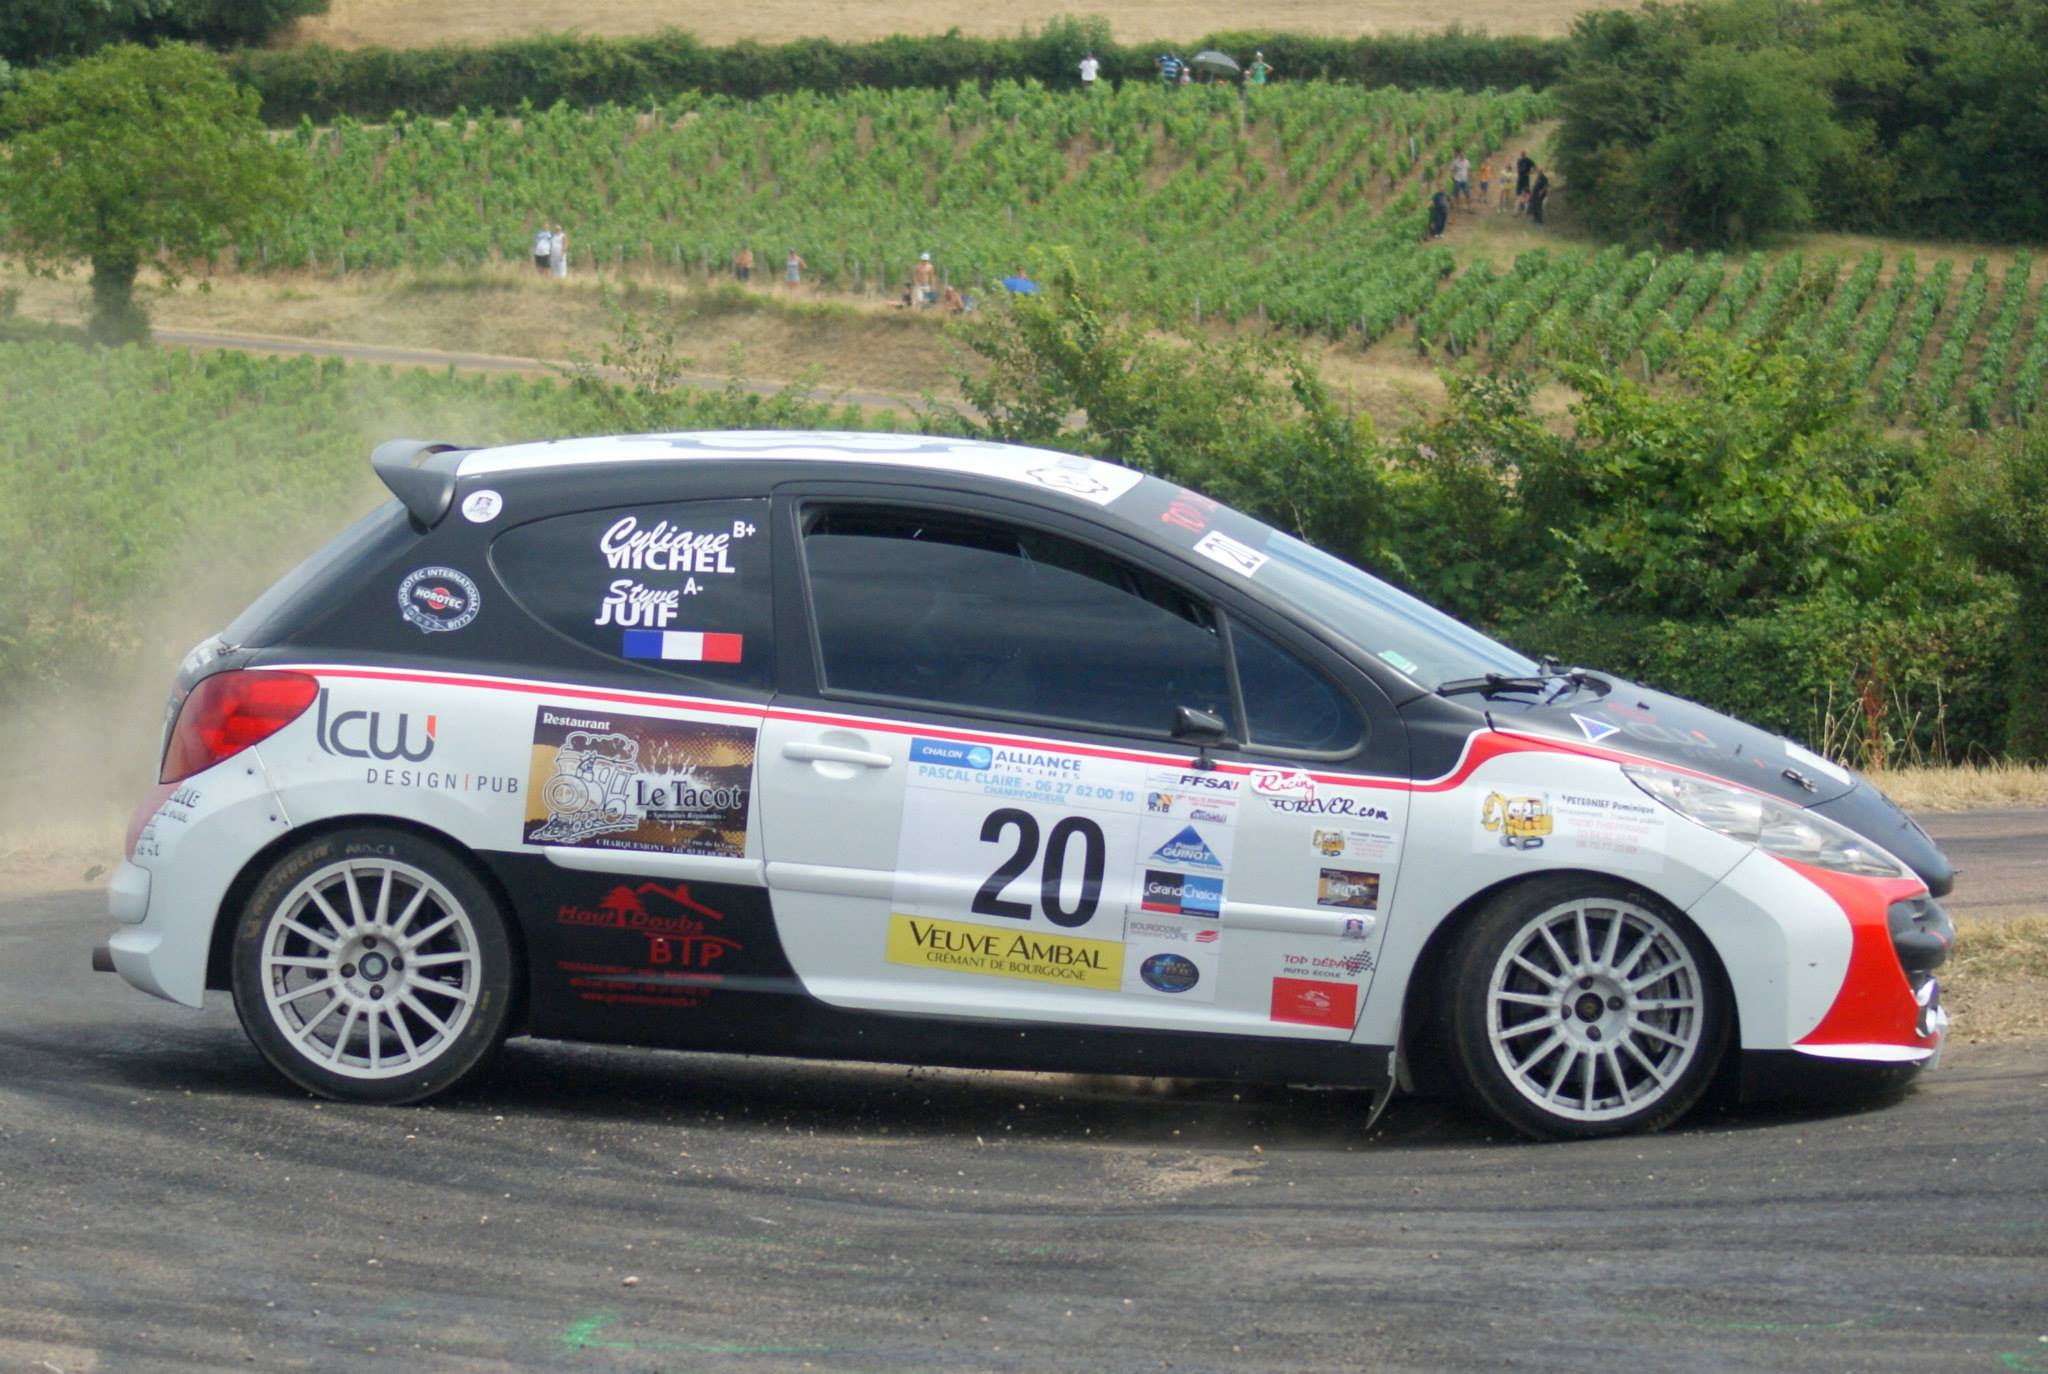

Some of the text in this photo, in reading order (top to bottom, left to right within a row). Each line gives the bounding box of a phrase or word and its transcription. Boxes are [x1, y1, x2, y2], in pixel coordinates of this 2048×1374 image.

[600, 516, 730, 559] Cyliane
[733, 520, 757, 538] B+
[606, 544, 736, 574] MICHEL
[683, 577, 704, 595] A-
[415, 588, 463, 609] HOROTEC
[594, 598, 679, 627] JUIF
[543, 712, 611, 731] Restaurant
[922, 746, 963, 760] CHALON
[995, 750, 1082, 772] ALLIANCE
[366, 769, 520, 794] DESIGN PUB
[994, 763, 1081, 780] PISCINES
[919, 766, 970, 783] PASCAL
[975, 772, 1022, 788] CLAIRE
[1035, 780, 1052, 793] 06
[1056, 782, 1073, 795] 27
[1096, 787, 1115, 800] 00
[1120, 790, 1135, 802] 10
[1179, 775, 1232, 791] FFSA
[635, 780, 743, 810] Le Tacot
[1163, 847, 1211, 861] GUINOT
[971, 807, 1106, 928] 20
[650, 936, 724, 969] BTP
[909, 920, 1000, 957] VEUVE
[1006, 934, 1108, 971] AMBAL
[926, 950, 1087, 982] CRÉMANT DE BOURGOGNE
[1283, 954, 1309, 965] TOP
[1283, 967, 1310, 976] AUTO
